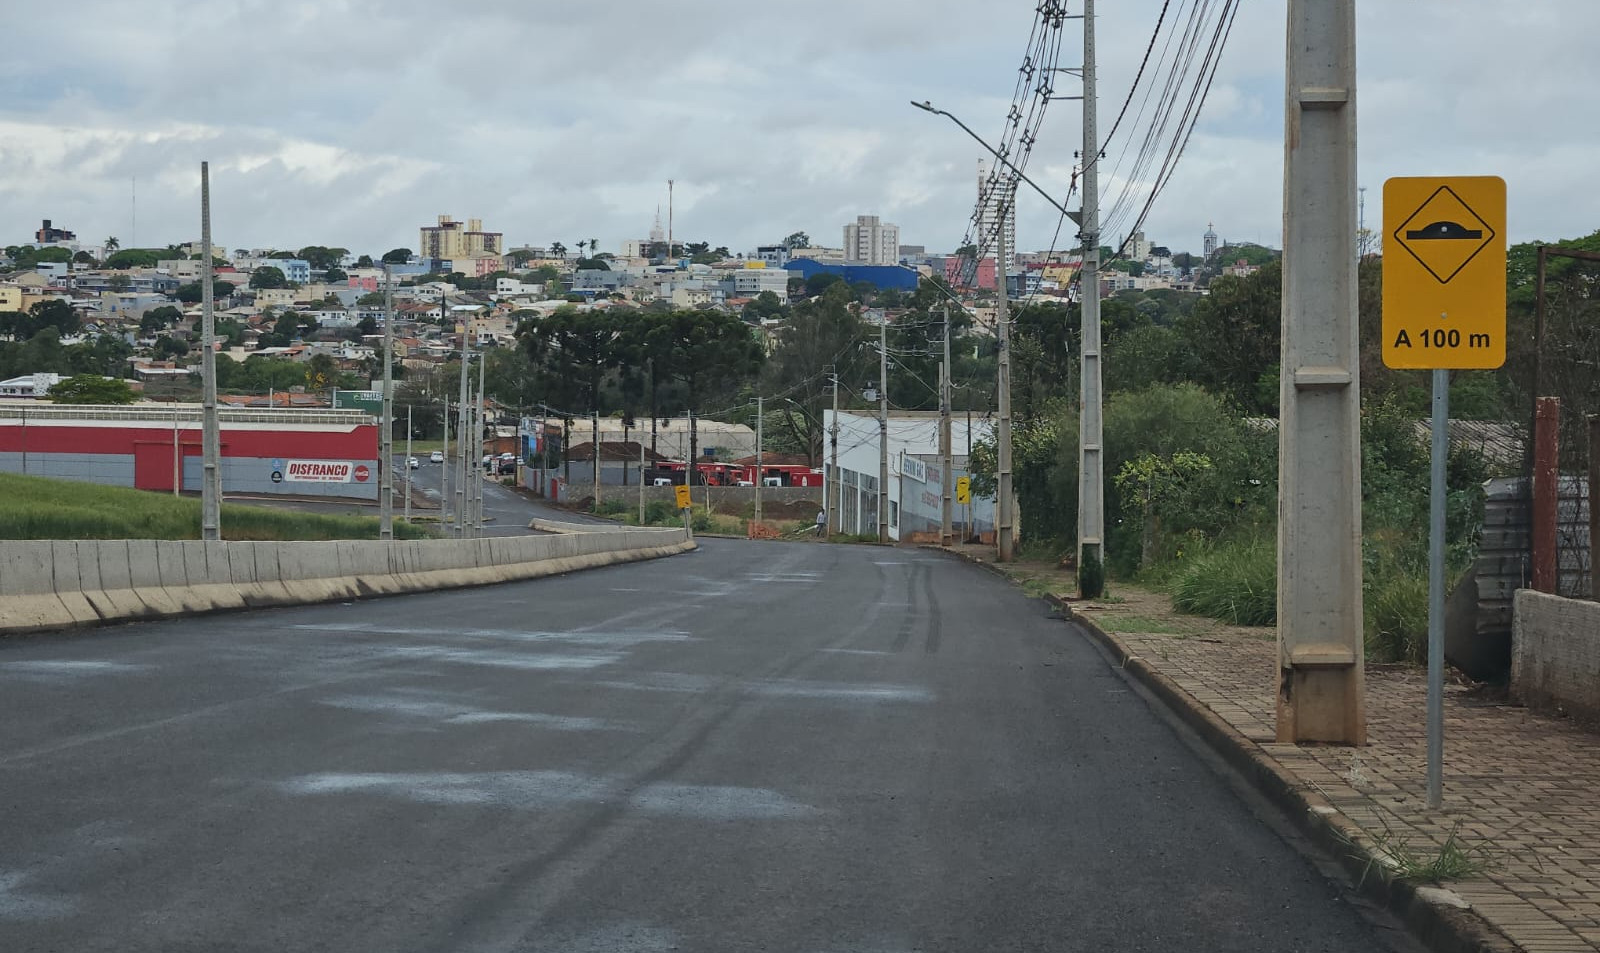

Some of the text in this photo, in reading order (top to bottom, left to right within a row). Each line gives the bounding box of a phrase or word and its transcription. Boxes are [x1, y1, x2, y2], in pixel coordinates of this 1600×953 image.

[1394, 329, 1490, 348] A 100 m
[289, 463, 349, 476] DISFRANCO
